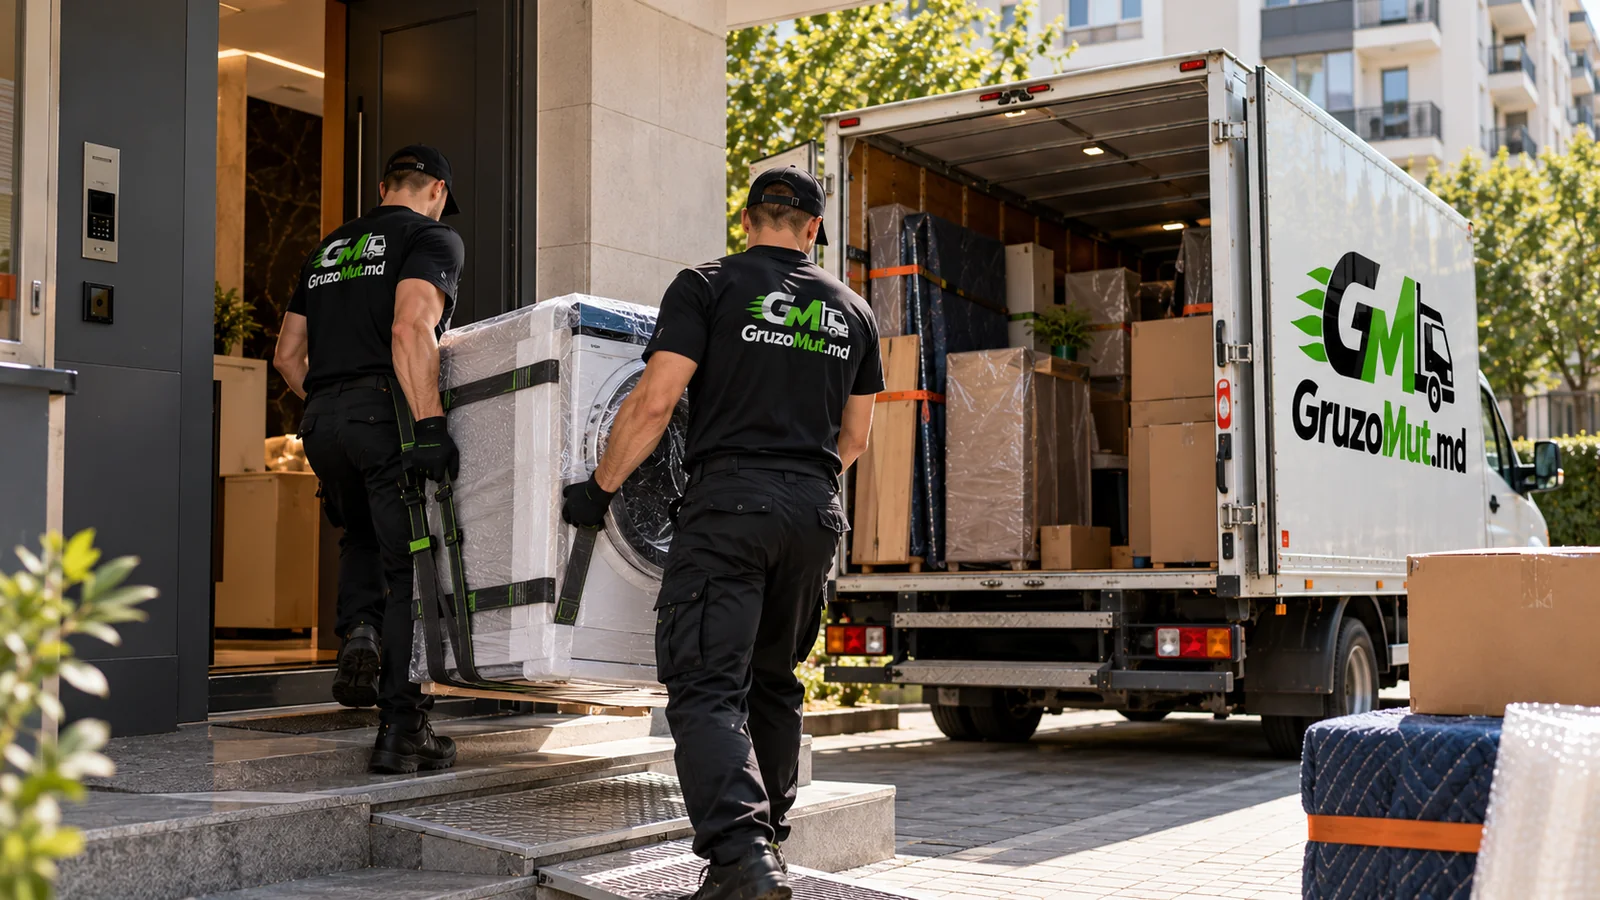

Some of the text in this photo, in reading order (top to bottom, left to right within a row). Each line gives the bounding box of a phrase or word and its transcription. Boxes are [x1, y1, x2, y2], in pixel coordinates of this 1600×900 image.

[308, 261, 386, 289] GruzoMut.md
[741, 324, 851, 360] GruzoMut.md
[1292, 378, 1467, 474] GruzoMut.md
